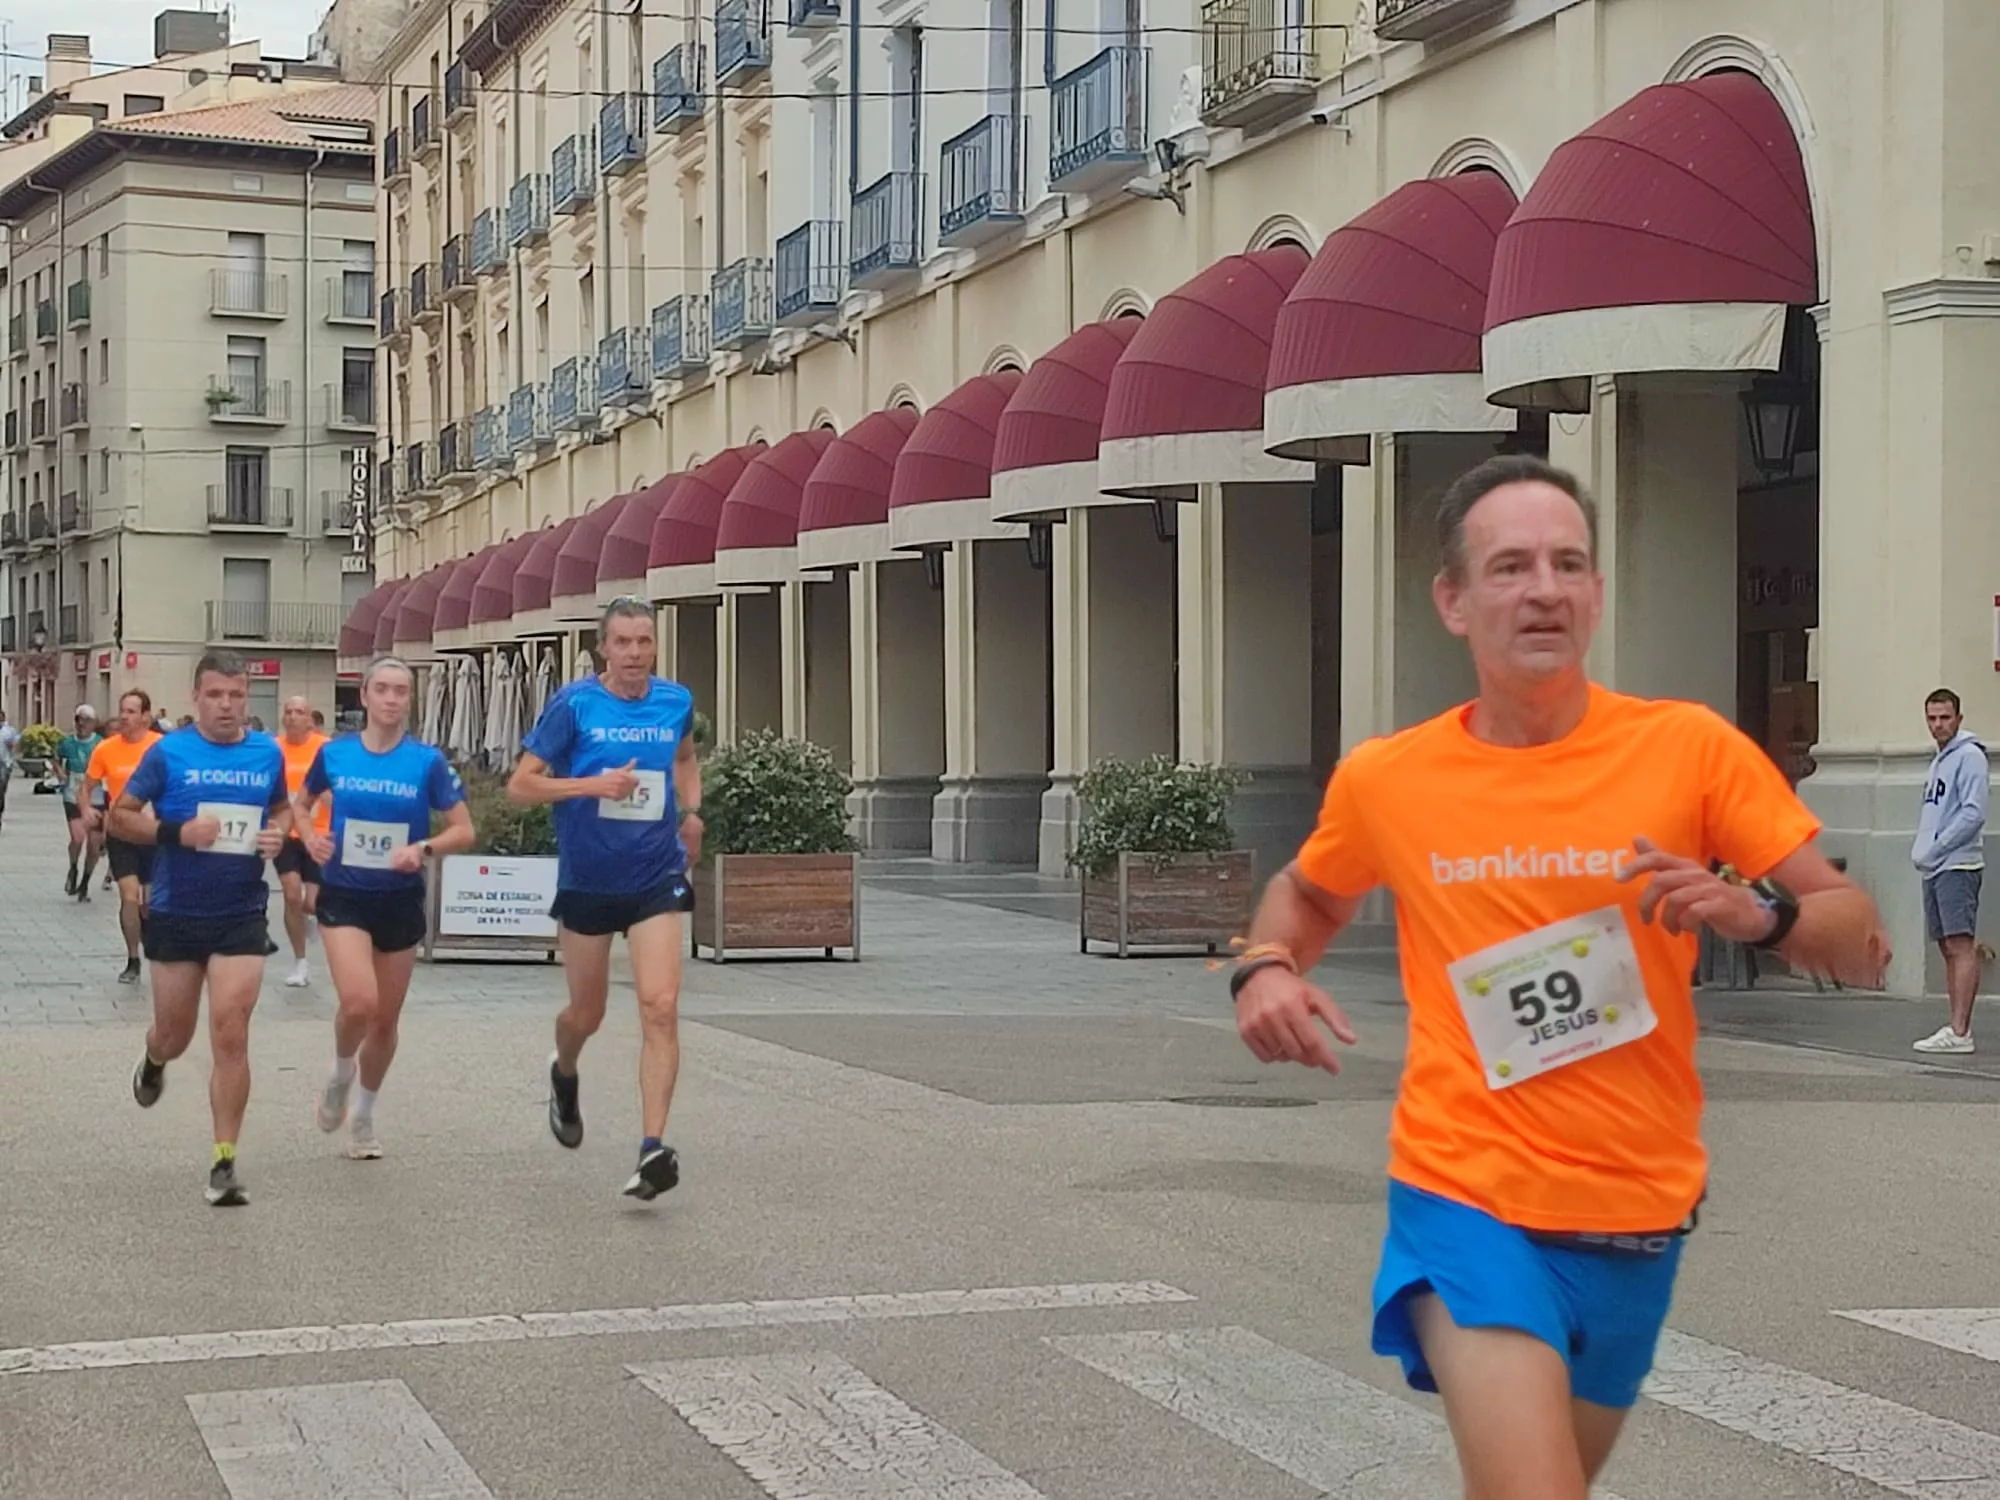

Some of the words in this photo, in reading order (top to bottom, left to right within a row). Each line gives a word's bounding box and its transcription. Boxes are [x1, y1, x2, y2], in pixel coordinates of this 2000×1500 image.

[352, 447, 367, 553] HOSTAL
[353, 832, 393, 851] 316
[1430, 845, 1629, 885] bankinter
[1509, 970, 1583, 1027] 59
[1529, 1008, 1599, 1046] JESUS
